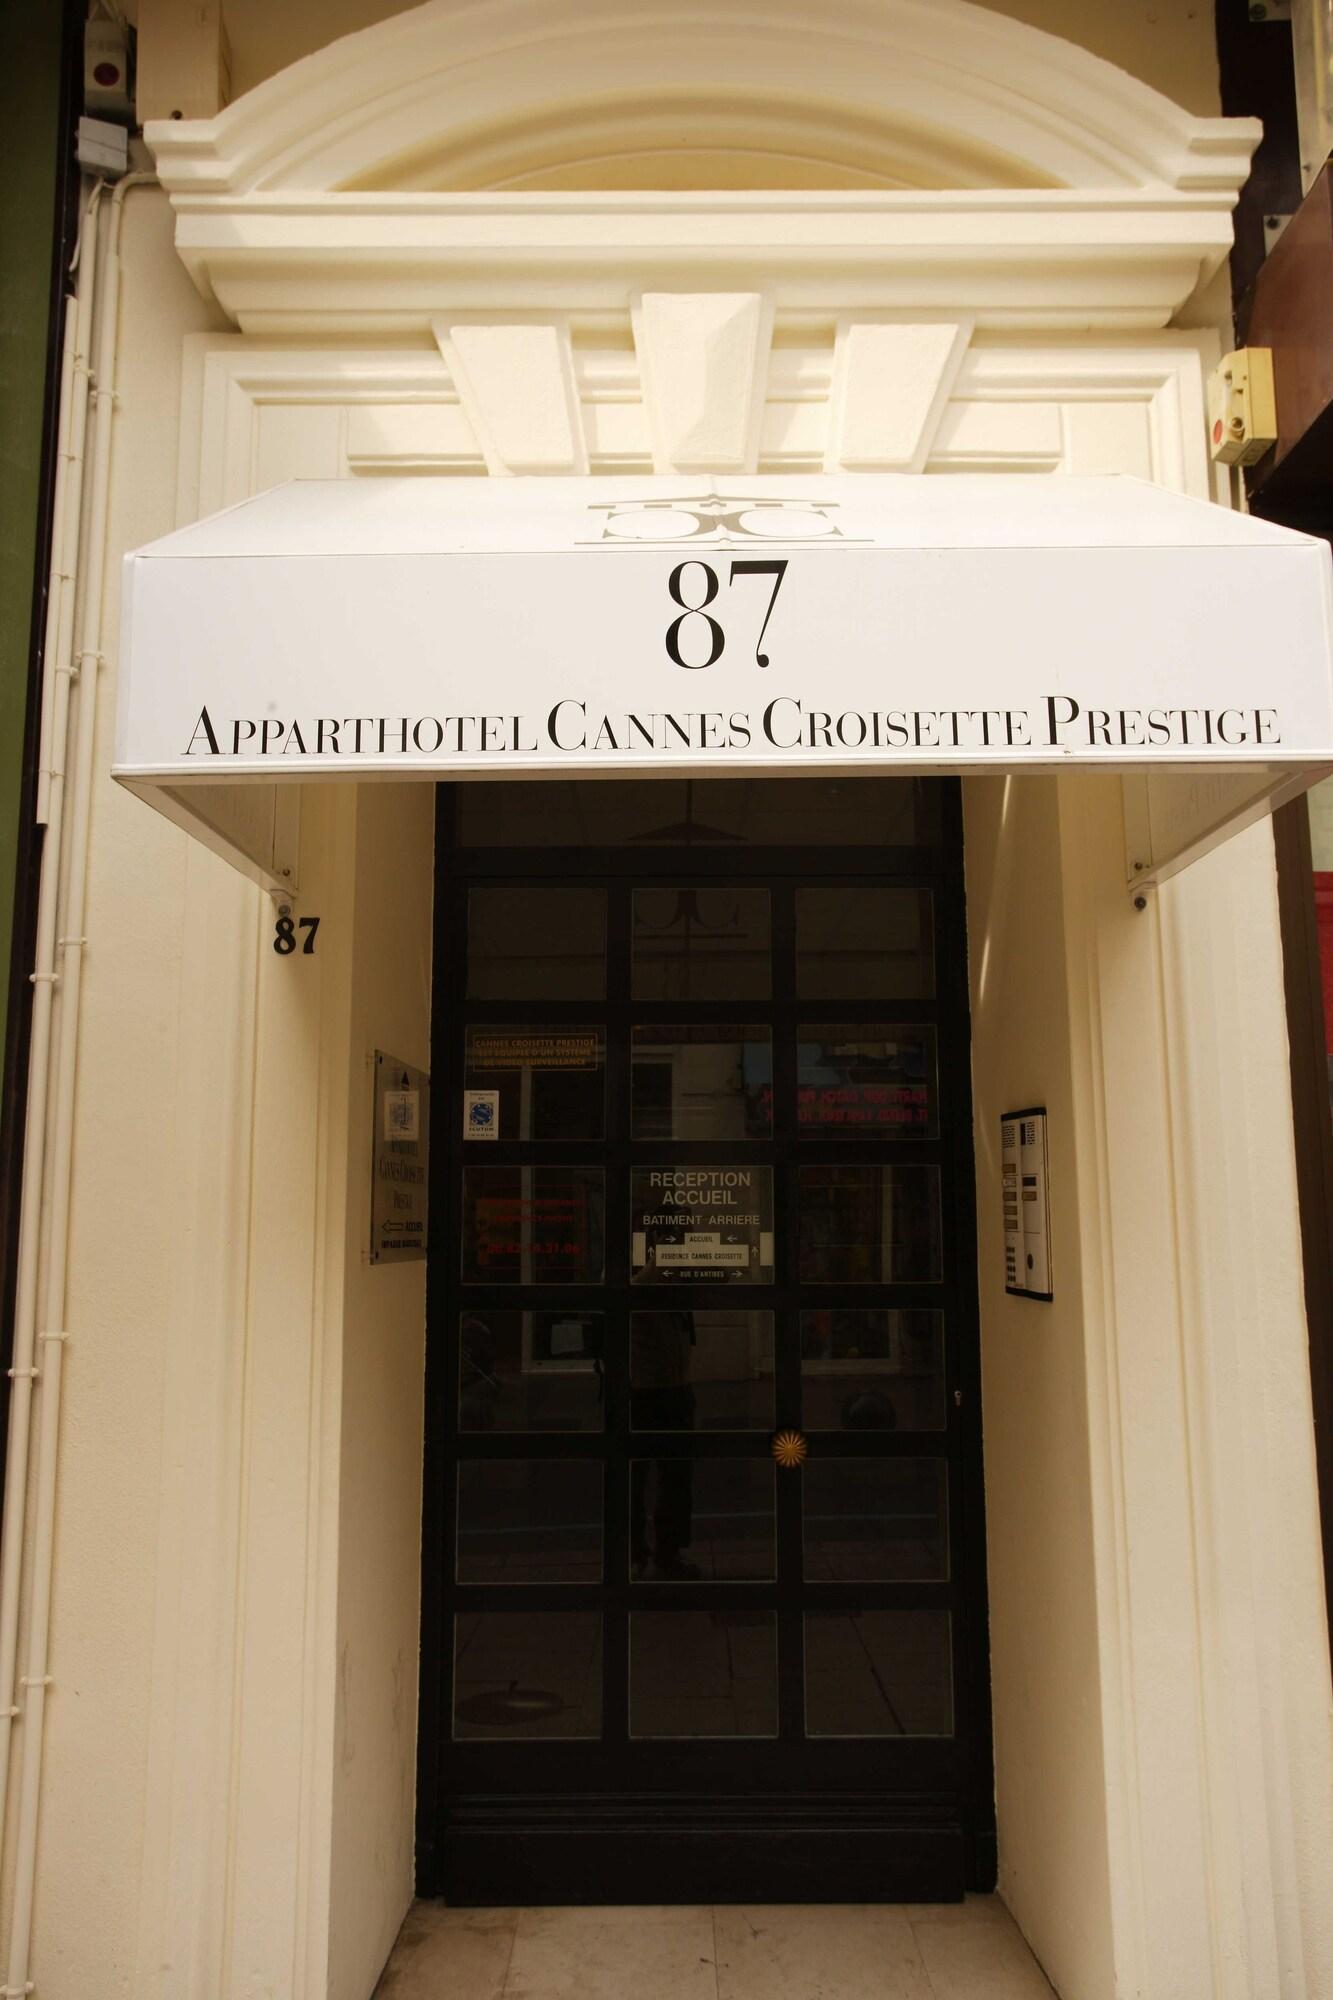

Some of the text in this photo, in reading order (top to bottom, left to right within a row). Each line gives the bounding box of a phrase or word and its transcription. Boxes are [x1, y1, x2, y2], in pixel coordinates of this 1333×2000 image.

[664, 558, 789, 670] 87
[180, 696, 1281, 756] APPARTHOTEL CANNES CROISETTE PRESTIGE
[273, 917, 321, 955] 87
[650, 1171, 751, 1188] RECEPTION
[662, 1190, 738, 1206] ACCUEIL
[643, 1215, 761, 1226] BATIMENT ARRIERE
